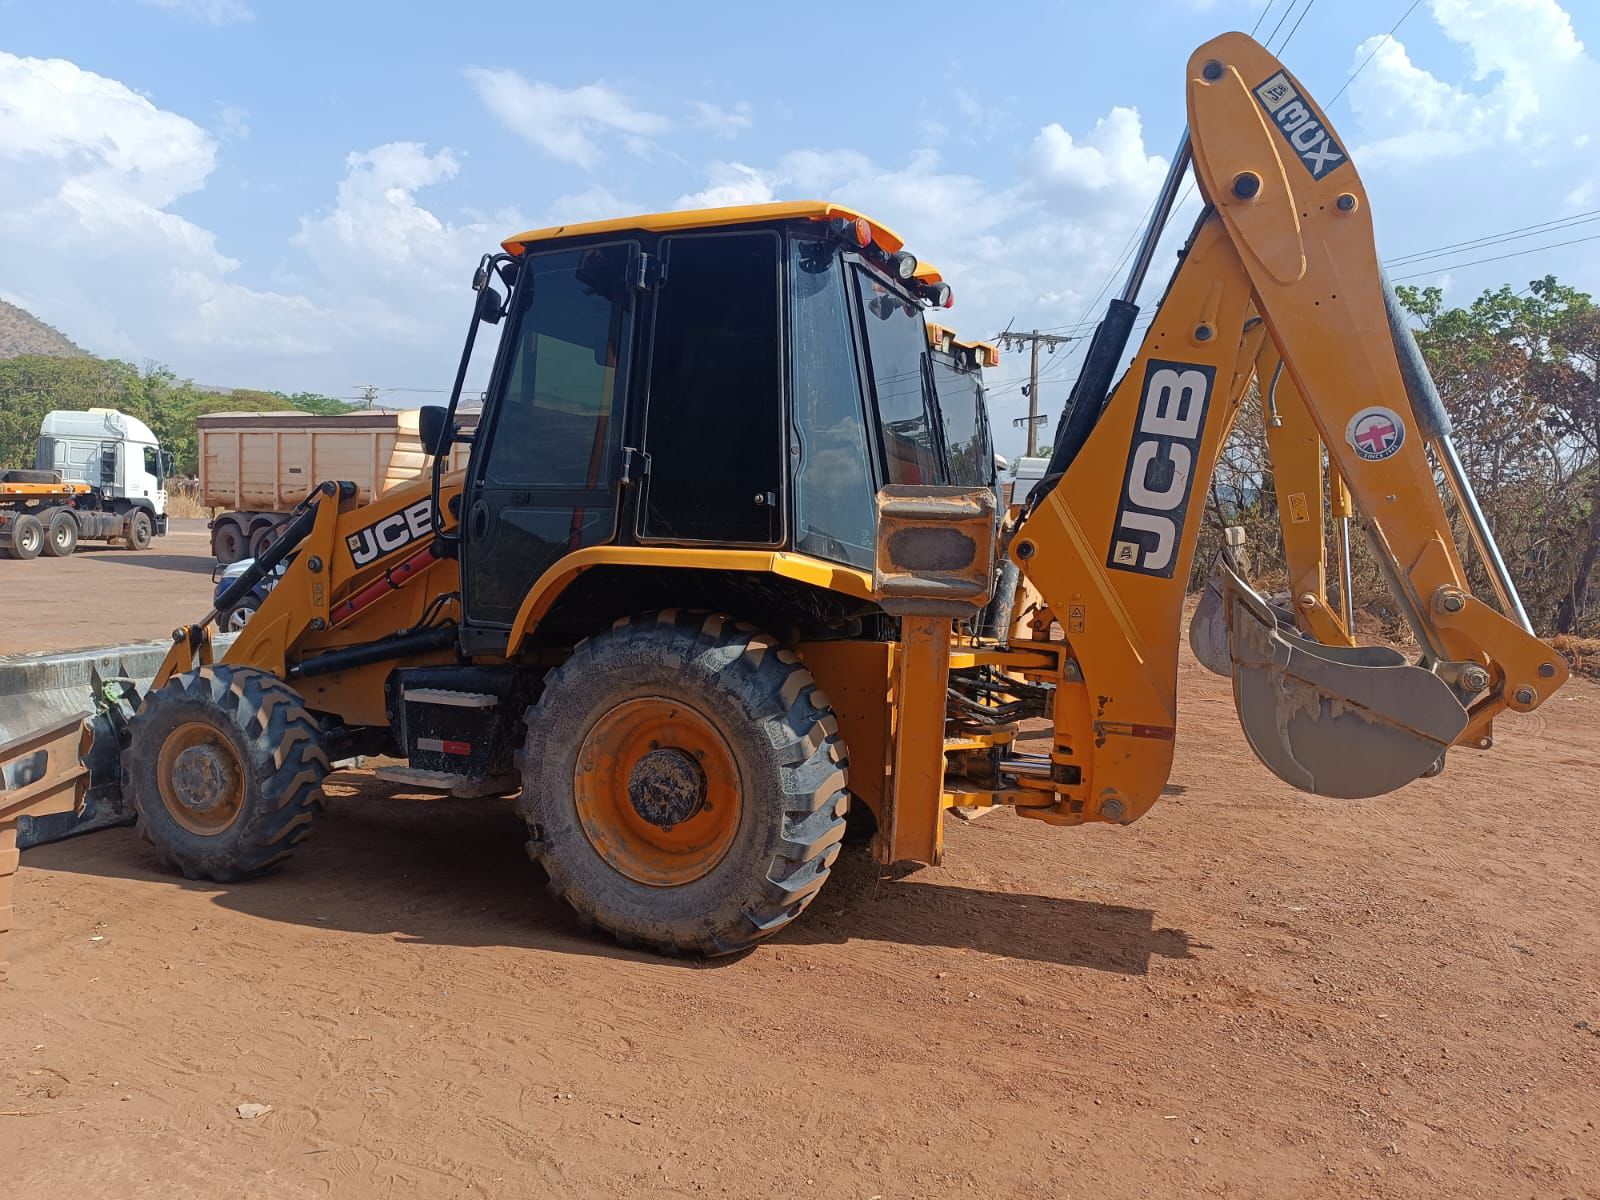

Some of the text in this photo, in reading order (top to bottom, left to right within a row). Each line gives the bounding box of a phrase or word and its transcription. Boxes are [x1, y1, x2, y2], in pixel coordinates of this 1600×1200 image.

[1277, 101, 1343, 175] 3CX
[1121, 369, 1207, 569] JCB
[353, 499, 442, 564] JCB
